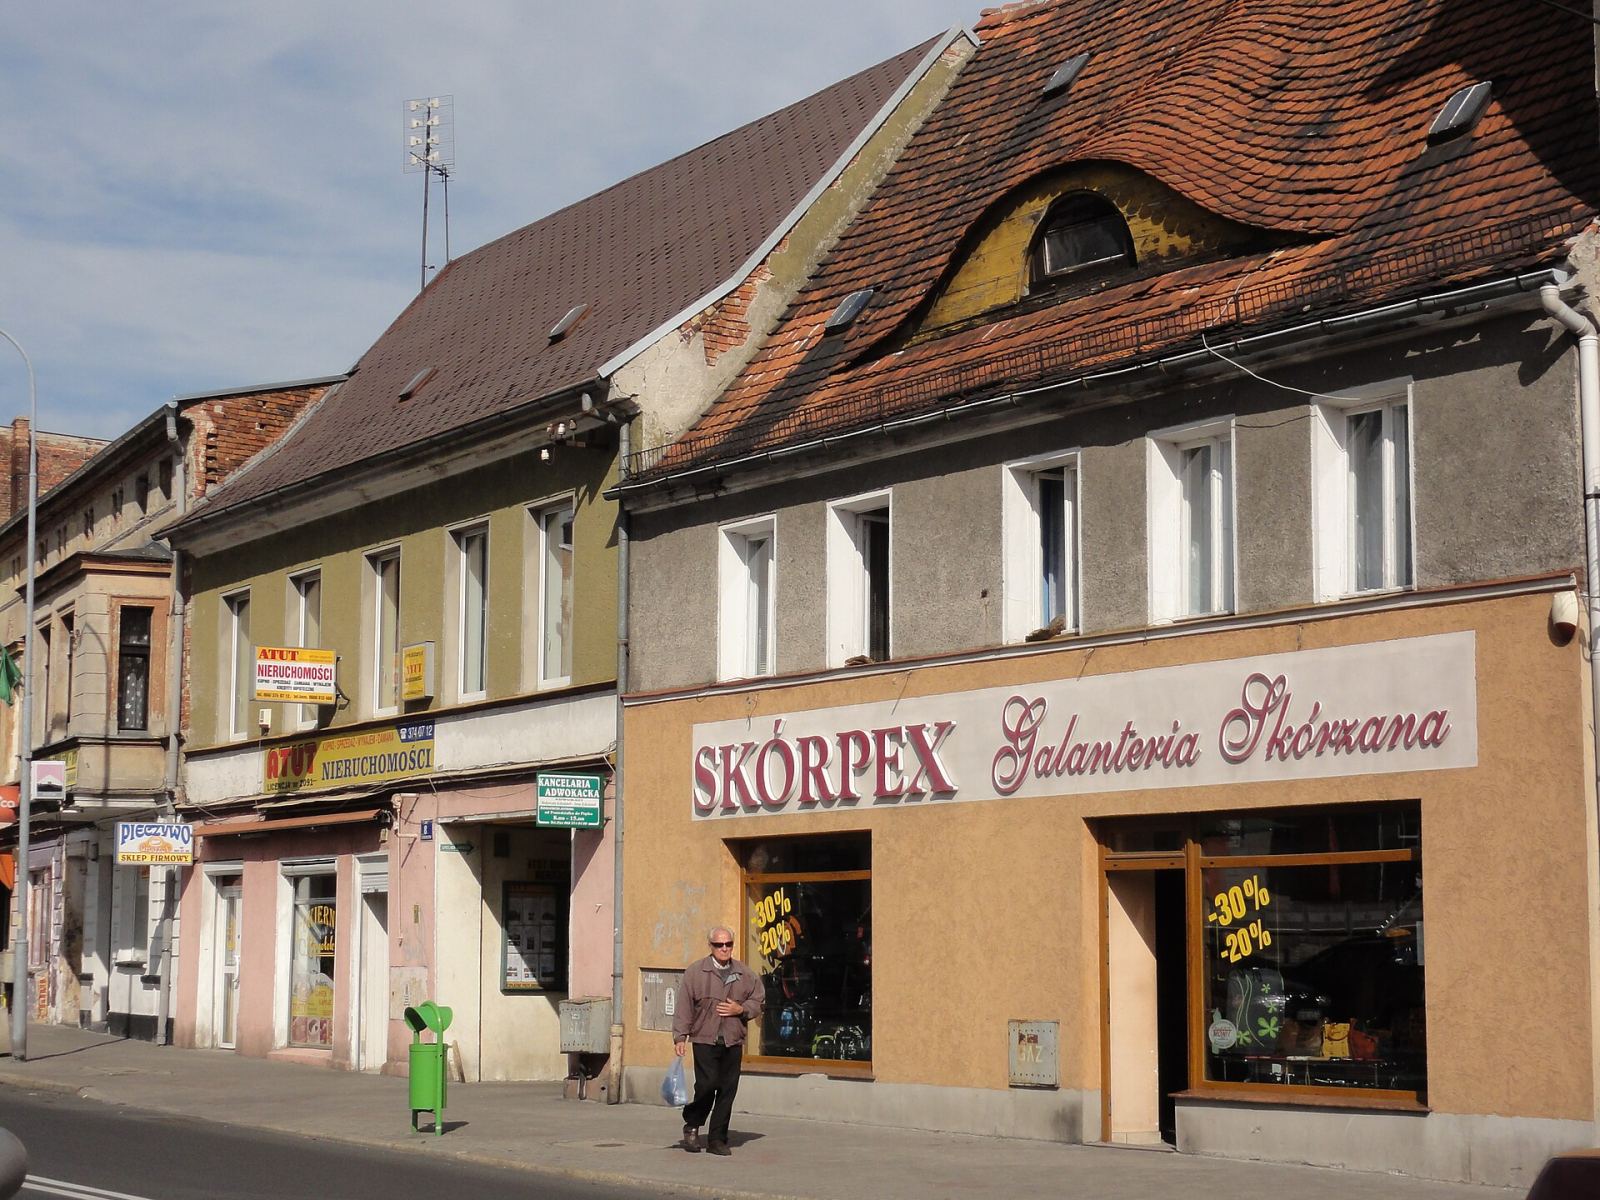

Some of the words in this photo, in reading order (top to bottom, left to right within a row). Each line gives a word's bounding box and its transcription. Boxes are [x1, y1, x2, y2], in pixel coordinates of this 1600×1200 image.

[259, 649, 299, 661] ATUT
[257, 664, 333, 681] NIERUCHOMOŚCI
[408, 726, 417, 739] 374
[425, 724, 433, 736] 12
[694, 718, 959, 812] SKÓRPEX
[992, 694, 1201, 796] Galanteria
[1219, 672, 1453, 763] Skórzana
[267, 741, 317, 779] ATUT
[322, 745, 432, 780] NIERUCHOMOŚCI
[538, 778, 591, 789] KANCELARIA
[544, 788, 600, 799] ADWOKACKA
[120, 824, 192, 846] PIECZYWO
[121, 854, 148, 862] SKLEP
[150, 854, 190, 862] FIRMOWY
[751, 886, 791, 928] -30%
[1208, 875, 1271, 927] -30%
[1221, 919, 1272, 964] -20%
